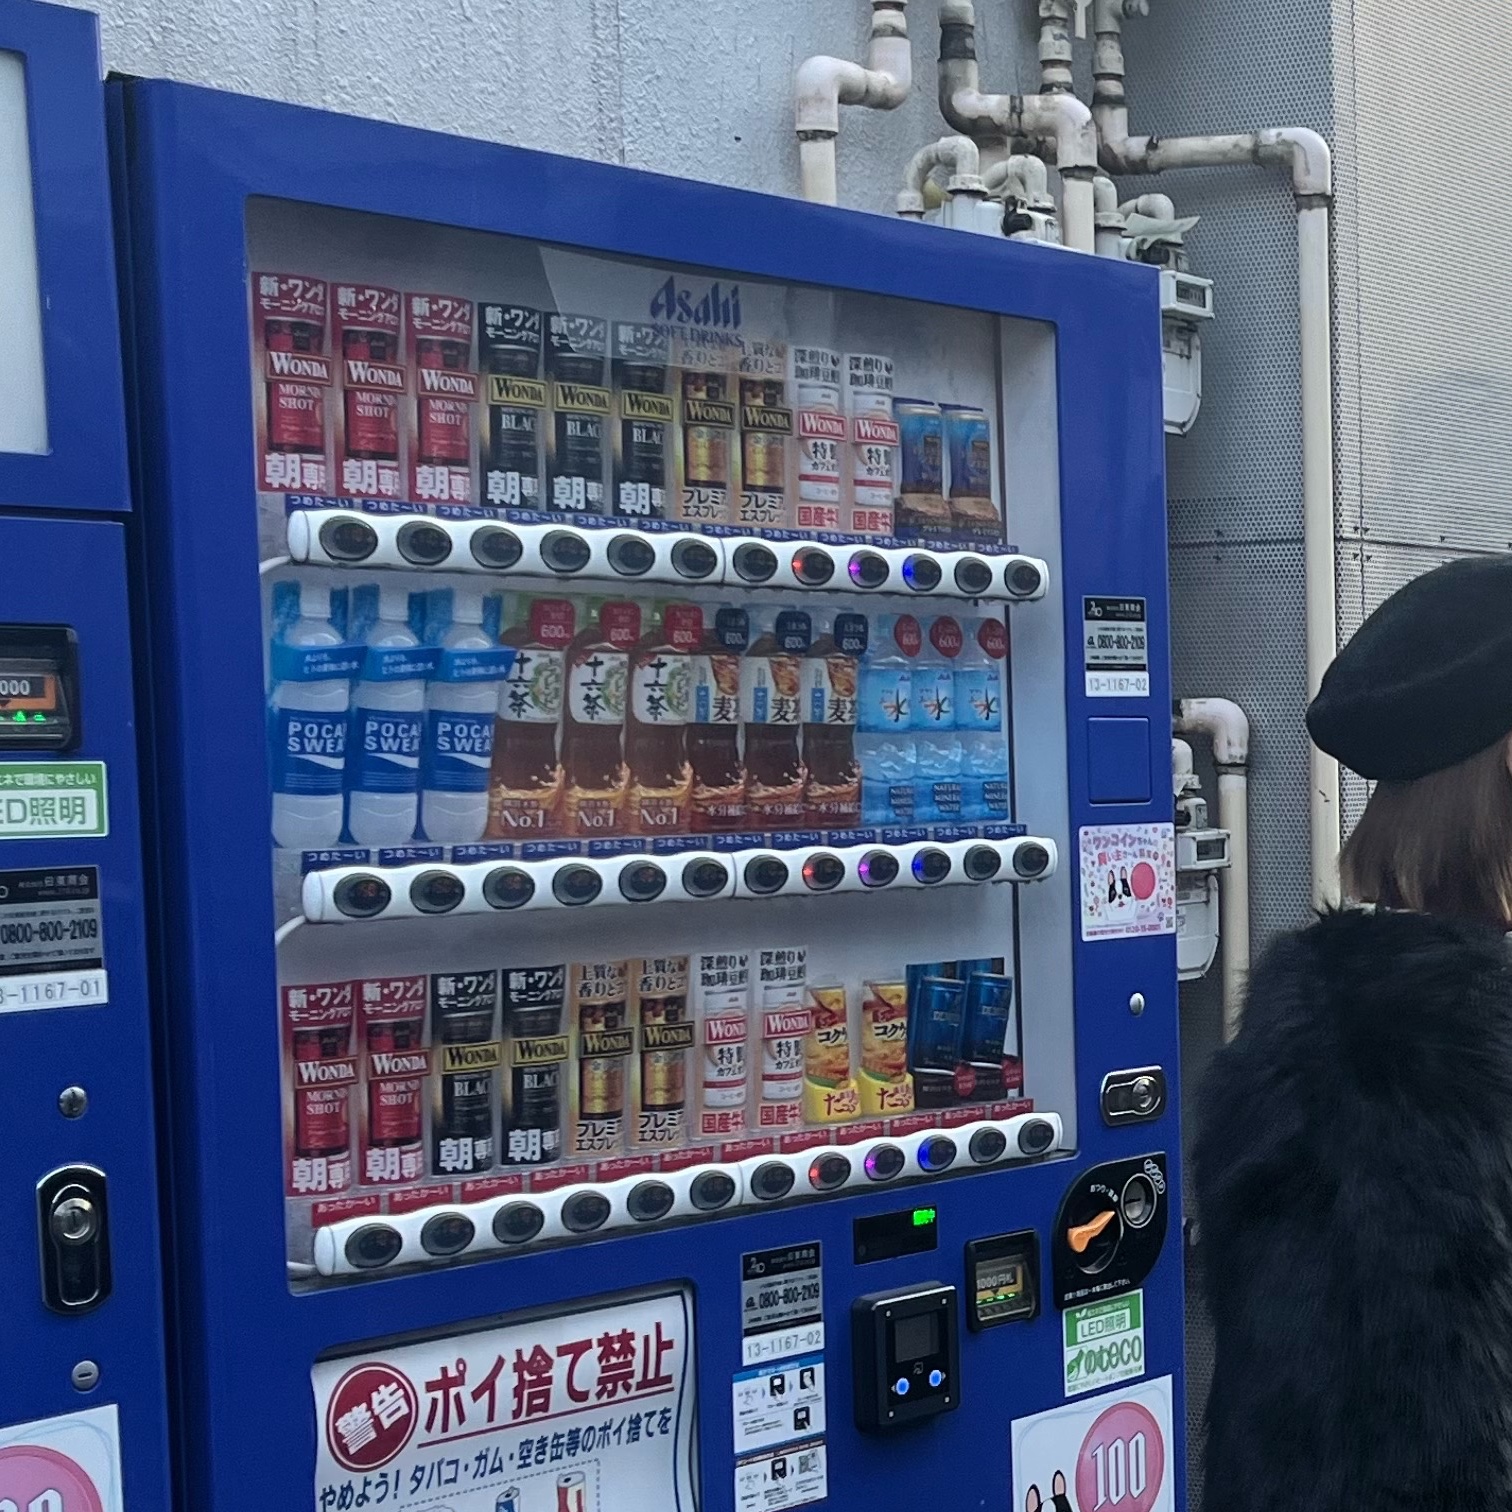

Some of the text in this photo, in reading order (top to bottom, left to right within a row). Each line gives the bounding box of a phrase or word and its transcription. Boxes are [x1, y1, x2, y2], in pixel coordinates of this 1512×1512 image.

[650, 275, 742, 330] Asahi
[270, 351, 328, 379] WONDA
[348, 360, 403, 387] WONDA
[422, 369, 474, 395] WONDA
[494, 377, 543, 401] WONDA
[560, 384, 608, 409] WONDA
[627, 392, 670, 416] WONDA
[687, 401, 734, 425] WONDA
[745, 405, 791, 428] WONDA
[802, 412, 845, 436] WONDA
[857, 419, 897, 441] WONDA
[506, 652, 534, 718] 十六茶
[580, 656, 606, 720] 十六茶
[644, 657, 669, 721] 十六茶
[288, 722, 346, 739] POCA
[365, 721, 421, 738] POCA
[437, 721, 494, 738] POCA
[0, 797, 86, 825] D照明
[503, 810, 544, 828] No.1
[578, 810, 615, 827] No.1
[641, 807, 677, 825] No.1
[1, 918, 98, 944] 0800-800-2109
[769, 1011, 810, 1032] WONDA
[583, 1031, 630, 1051] WONDA
[645, 1025, 691, 1046] WONDA
[449, 1046, 497, 1066] WONDA
[518, 1038, 566, 1060] WONDA
[299, 1061, 354, 1084] WONDA
[371, 1053, 427, 1075] WONDA
[306, 1102, 340, 1115] SHOT
[379, 1093, 413, 1106] SHOT
[1080, 1312, 1127, 1339] LED照明
[747, 1329, 821, 1358] 13-1167-02
[424, 1321, 676, 1435] ポイ捨て禁止
[336, 1382, 411, 1457] 警告
[1091, 1431, 1147, 1512] 100
